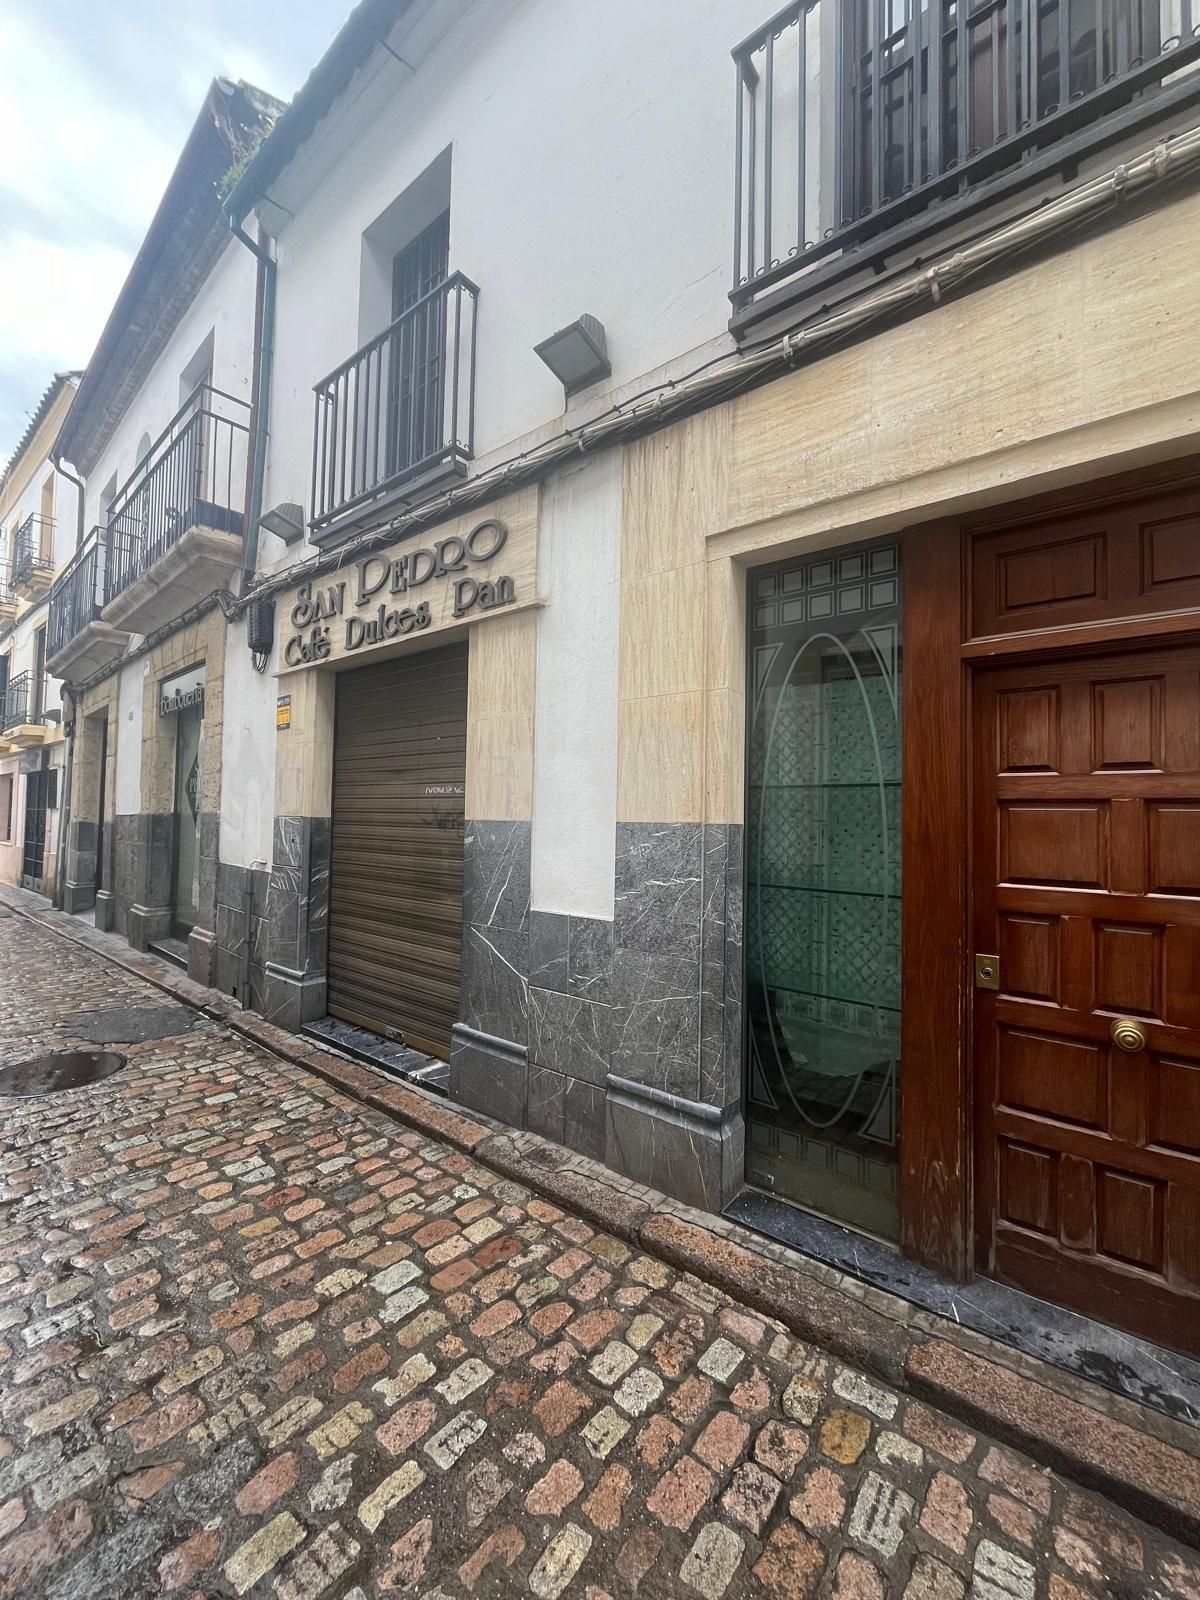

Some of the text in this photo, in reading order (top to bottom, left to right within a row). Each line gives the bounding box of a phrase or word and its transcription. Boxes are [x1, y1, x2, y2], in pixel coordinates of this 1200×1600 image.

[284, 576, 516, 666] Café Dulces Pan
[291, 519, 508, 628] SAN PEDRO
